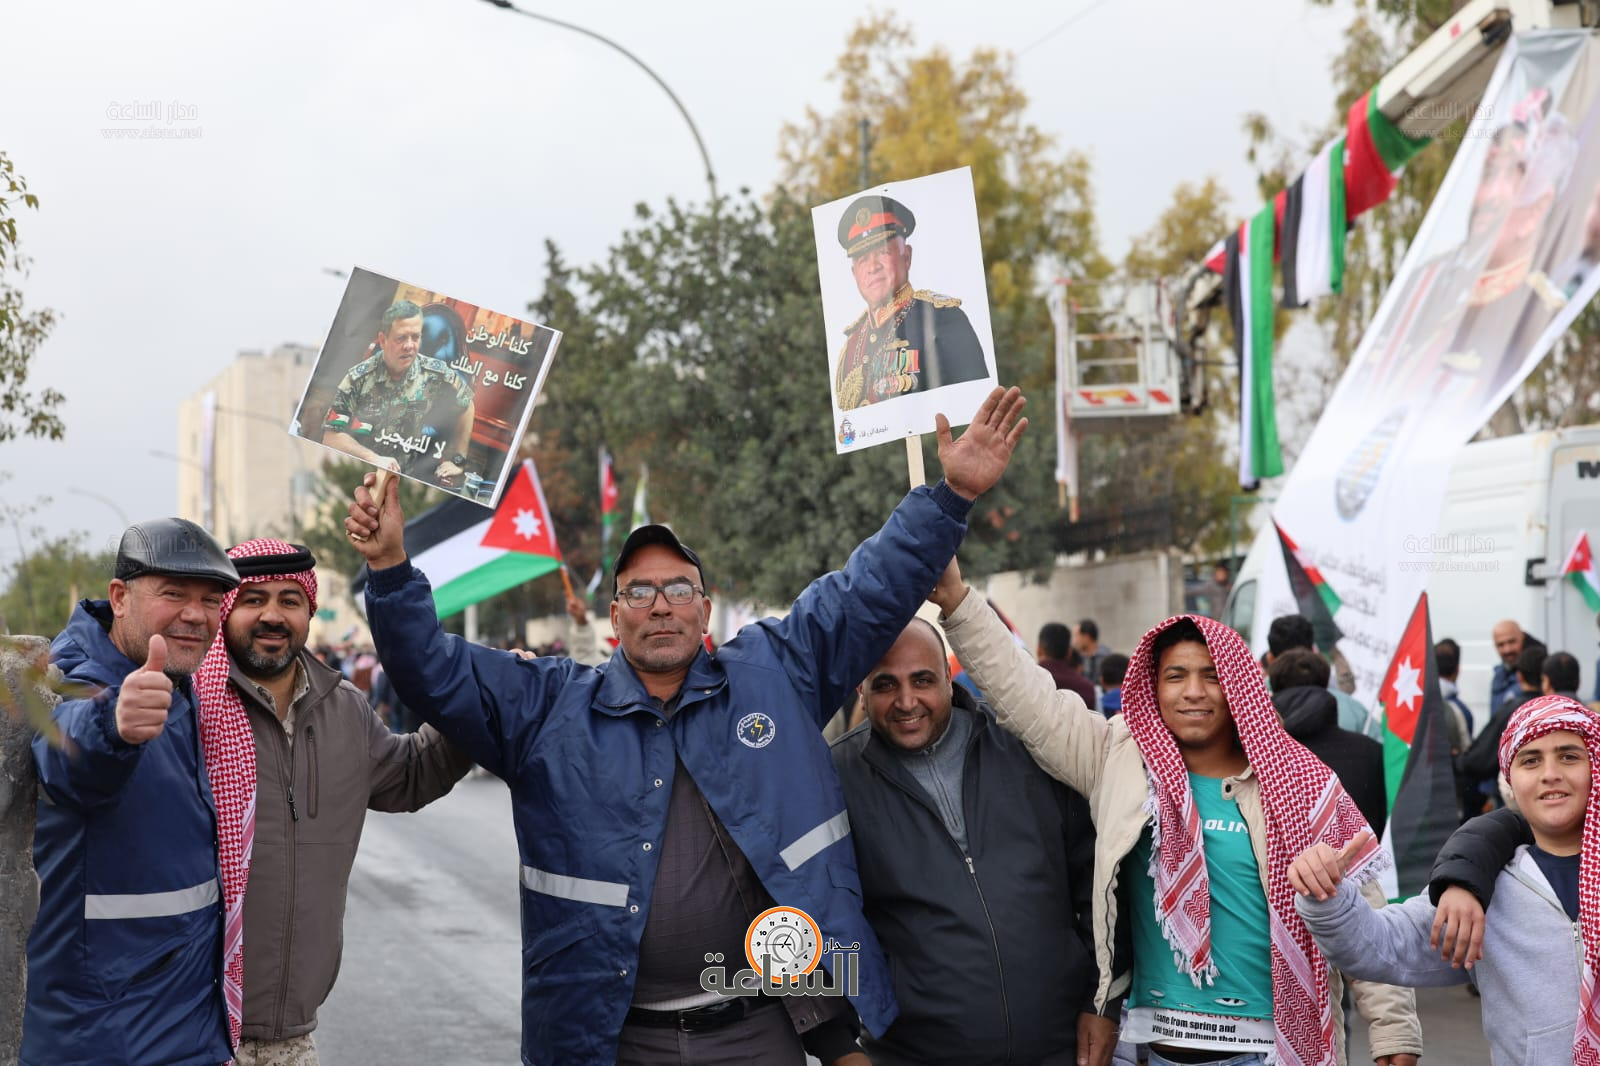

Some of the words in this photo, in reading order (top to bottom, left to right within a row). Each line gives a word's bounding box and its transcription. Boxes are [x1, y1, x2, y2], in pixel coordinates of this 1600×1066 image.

[465, 326, 507, 349] الوطن
[508, 336, 533, 355] كلنا
[450, 355, 484, 377] الملك
[482, 369, 499, 386] مع
[503, 371, 528, 390] كلنا
[374, 427, 432, 454] للتهجير
[432, 440, 447, 460] لا
[1170, 1016, 1188, 1028] from
[1189, 1020, 1218, 1033] spring
[1219, 1024, 1236, 1034] and
[1175, 1029, 1183, 1039] in
